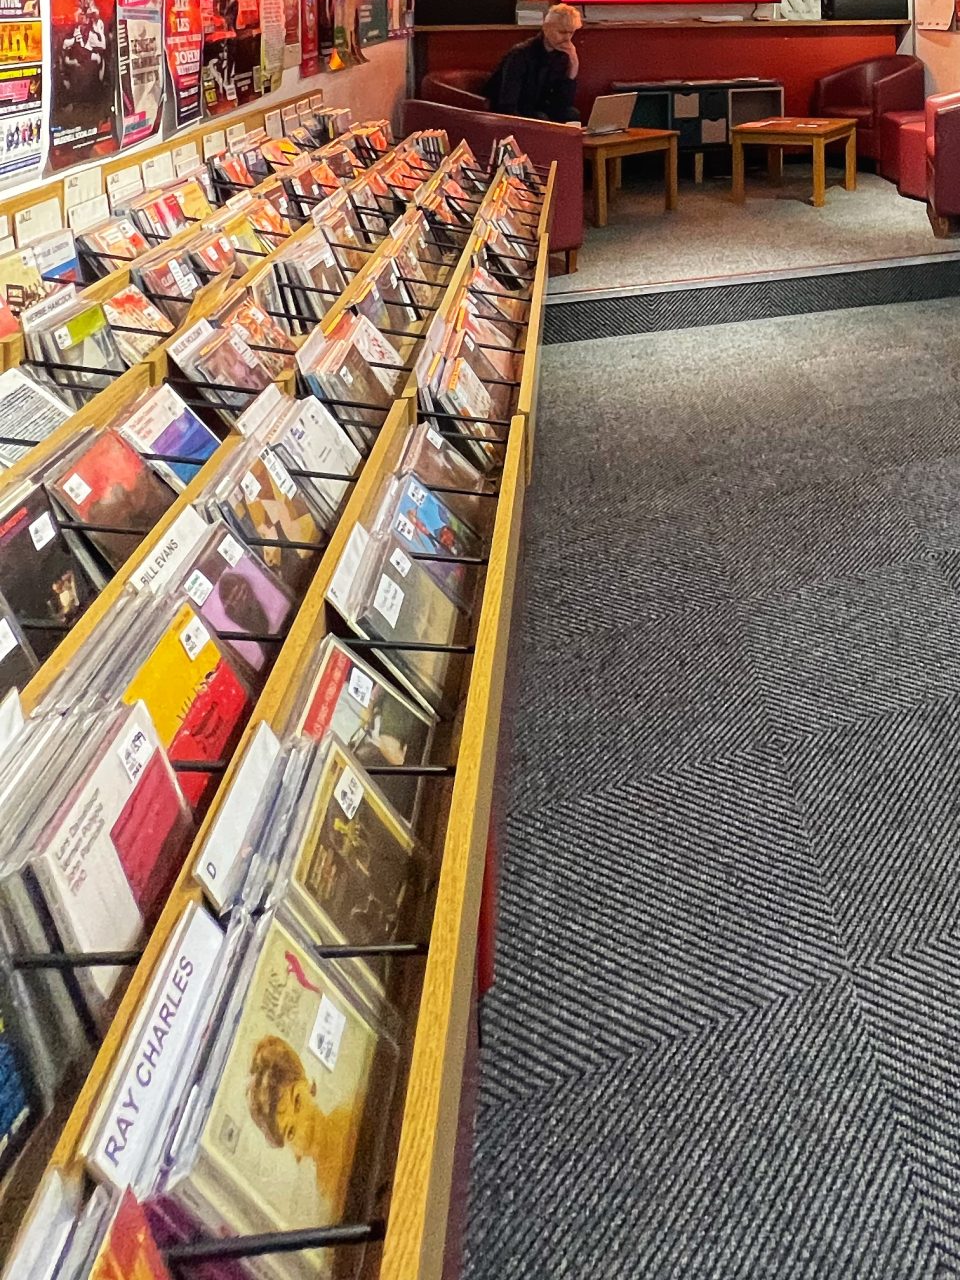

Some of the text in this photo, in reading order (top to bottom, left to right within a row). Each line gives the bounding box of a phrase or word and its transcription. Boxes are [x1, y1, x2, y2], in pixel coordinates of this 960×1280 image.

[140, 538, 179, 587] BILL EVANS
[103, 955, 195, 1167] RAY CHARLES
